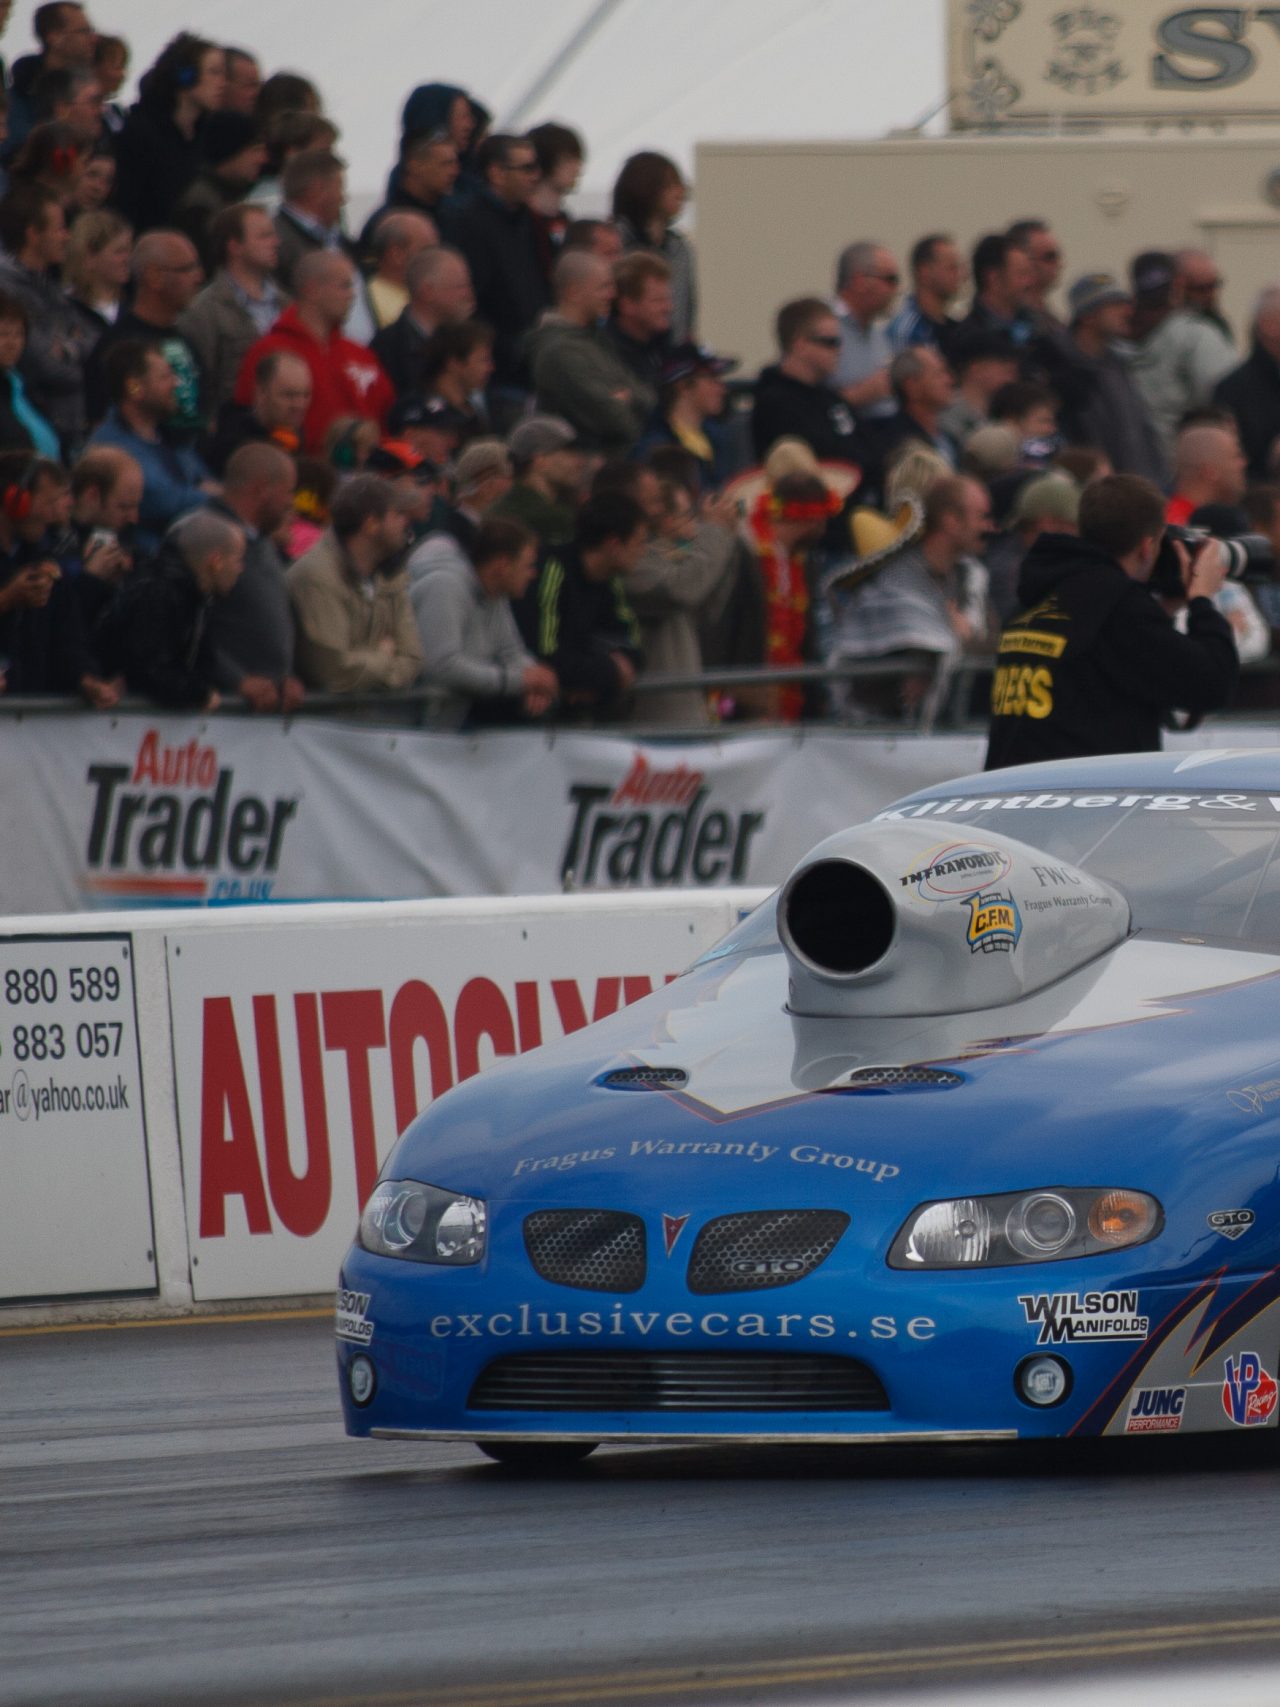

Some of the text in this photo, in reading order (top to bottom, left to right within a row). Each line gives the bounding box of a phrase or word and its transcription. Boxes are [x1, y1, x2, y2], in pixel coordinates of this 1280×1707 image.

[132, 729, 217, 788] Auto
[612, 750, 705, 808] Auto
[87, 764, 299, 873] Trader
[561, 784, 766, 885] Trader
[900, 851, 1008, 886] INFRANORDIC
[975, 908, 1014, 933] C.F.M.
[1025, 899, 1051, 912] Fragus
[1053, 896, 1090, 909] Warranty
[4, 966, 120, 1005] 880 589
[13, 1021, 123, 1062] 883 057
[511, 1139, 900, 1182] Fragus Warranty Group
[1211, 1211, 1251, 1225] GTO
[733, 1258, 804, 1274] GTO
[430, 1302, 937, 1341] exclusivecars.se
[1019, 1291, 1138, 1321] WILSON
[1038, 1316, 1148, 1343] MANIFOLDS
[1131, 1388, 1185, 1417] JUNG
[1224, 1352, 1262, 1424] VP
[1128, 1417, 1180, 1431] PERFORMANCE
